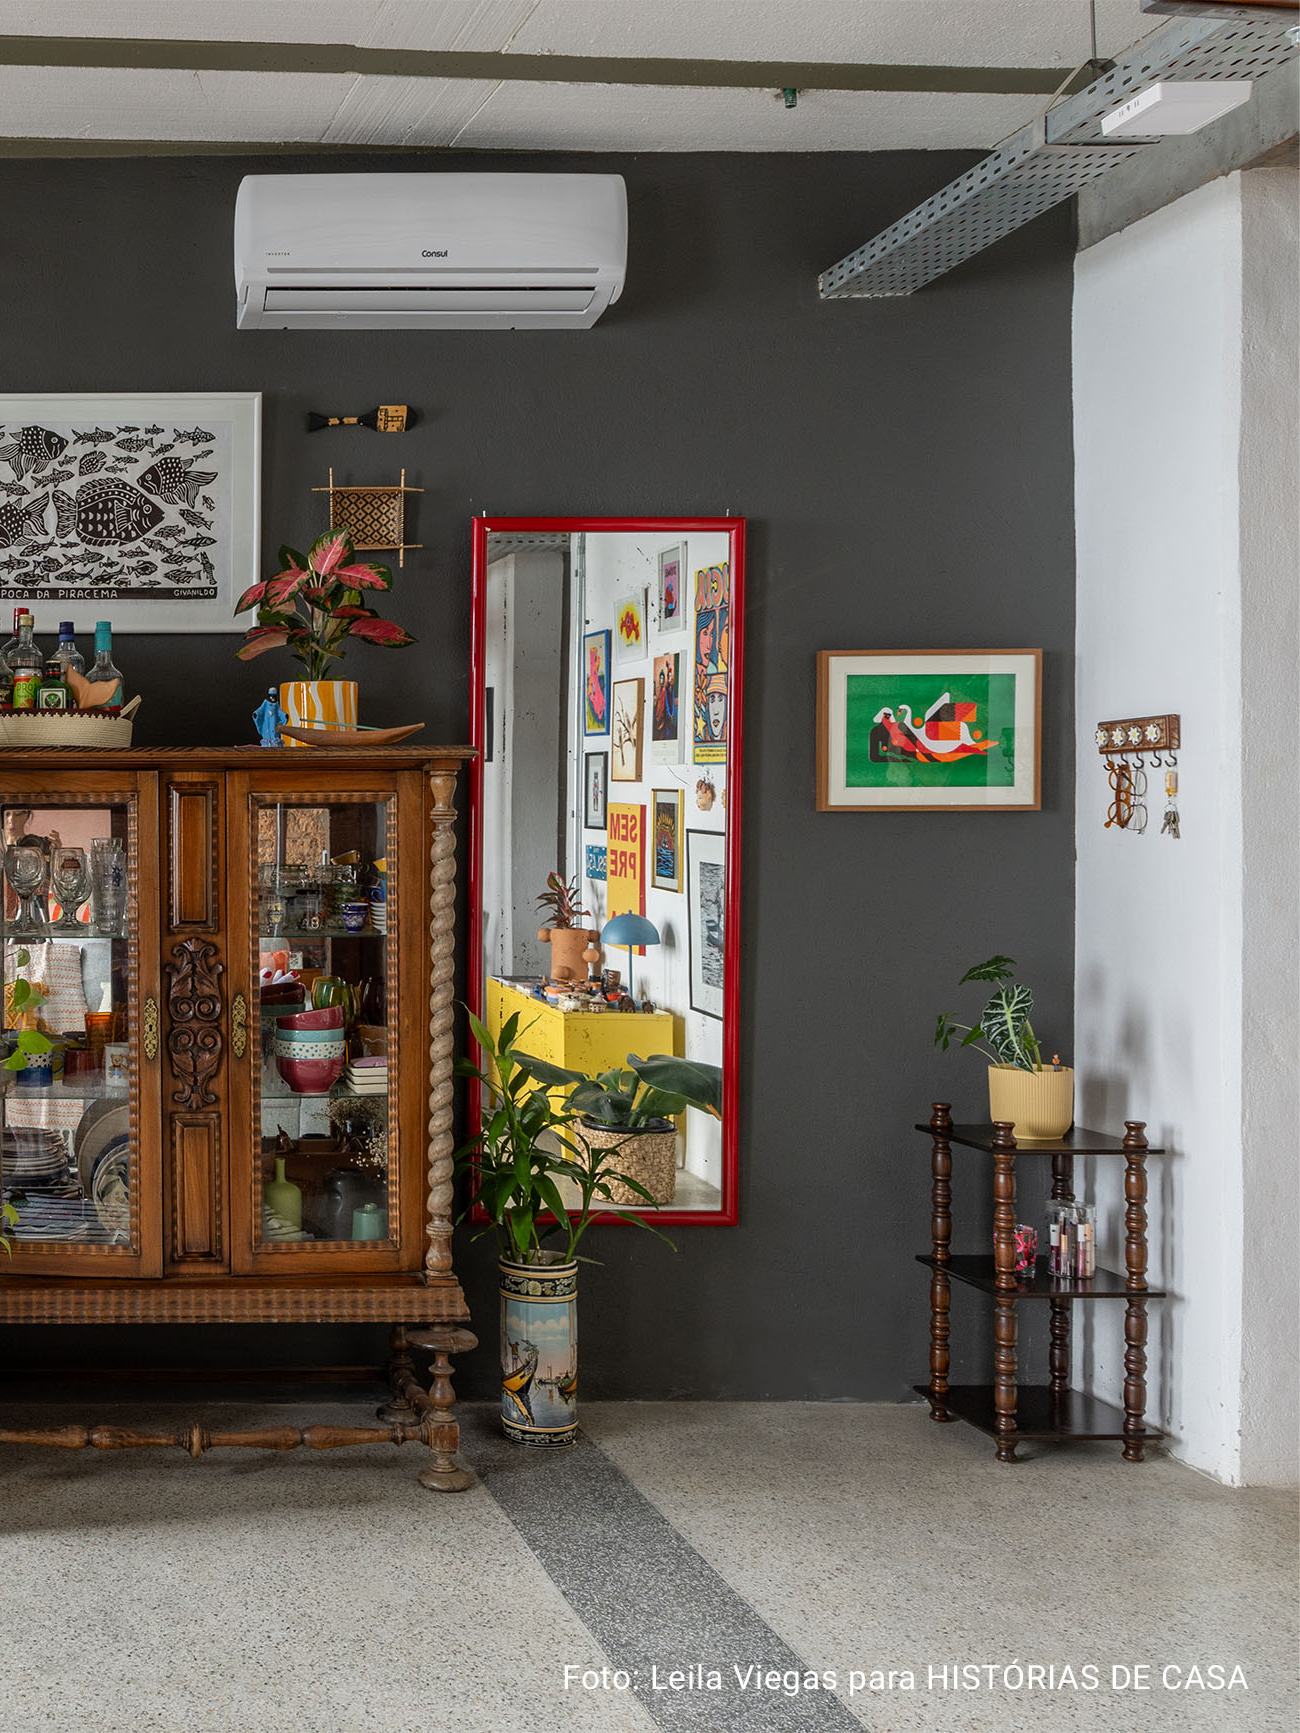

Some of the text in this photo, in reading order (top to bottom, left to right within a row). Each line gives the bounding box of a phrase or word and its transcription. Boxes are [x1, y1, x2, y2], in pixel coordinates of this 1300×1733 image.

[421, 249, 448, 258] Consul
[36, 589, 50, 600] DA
[59, 588, 118, 599] PIRACEMA
[173, 588, 215, 597] GIVANILDO
